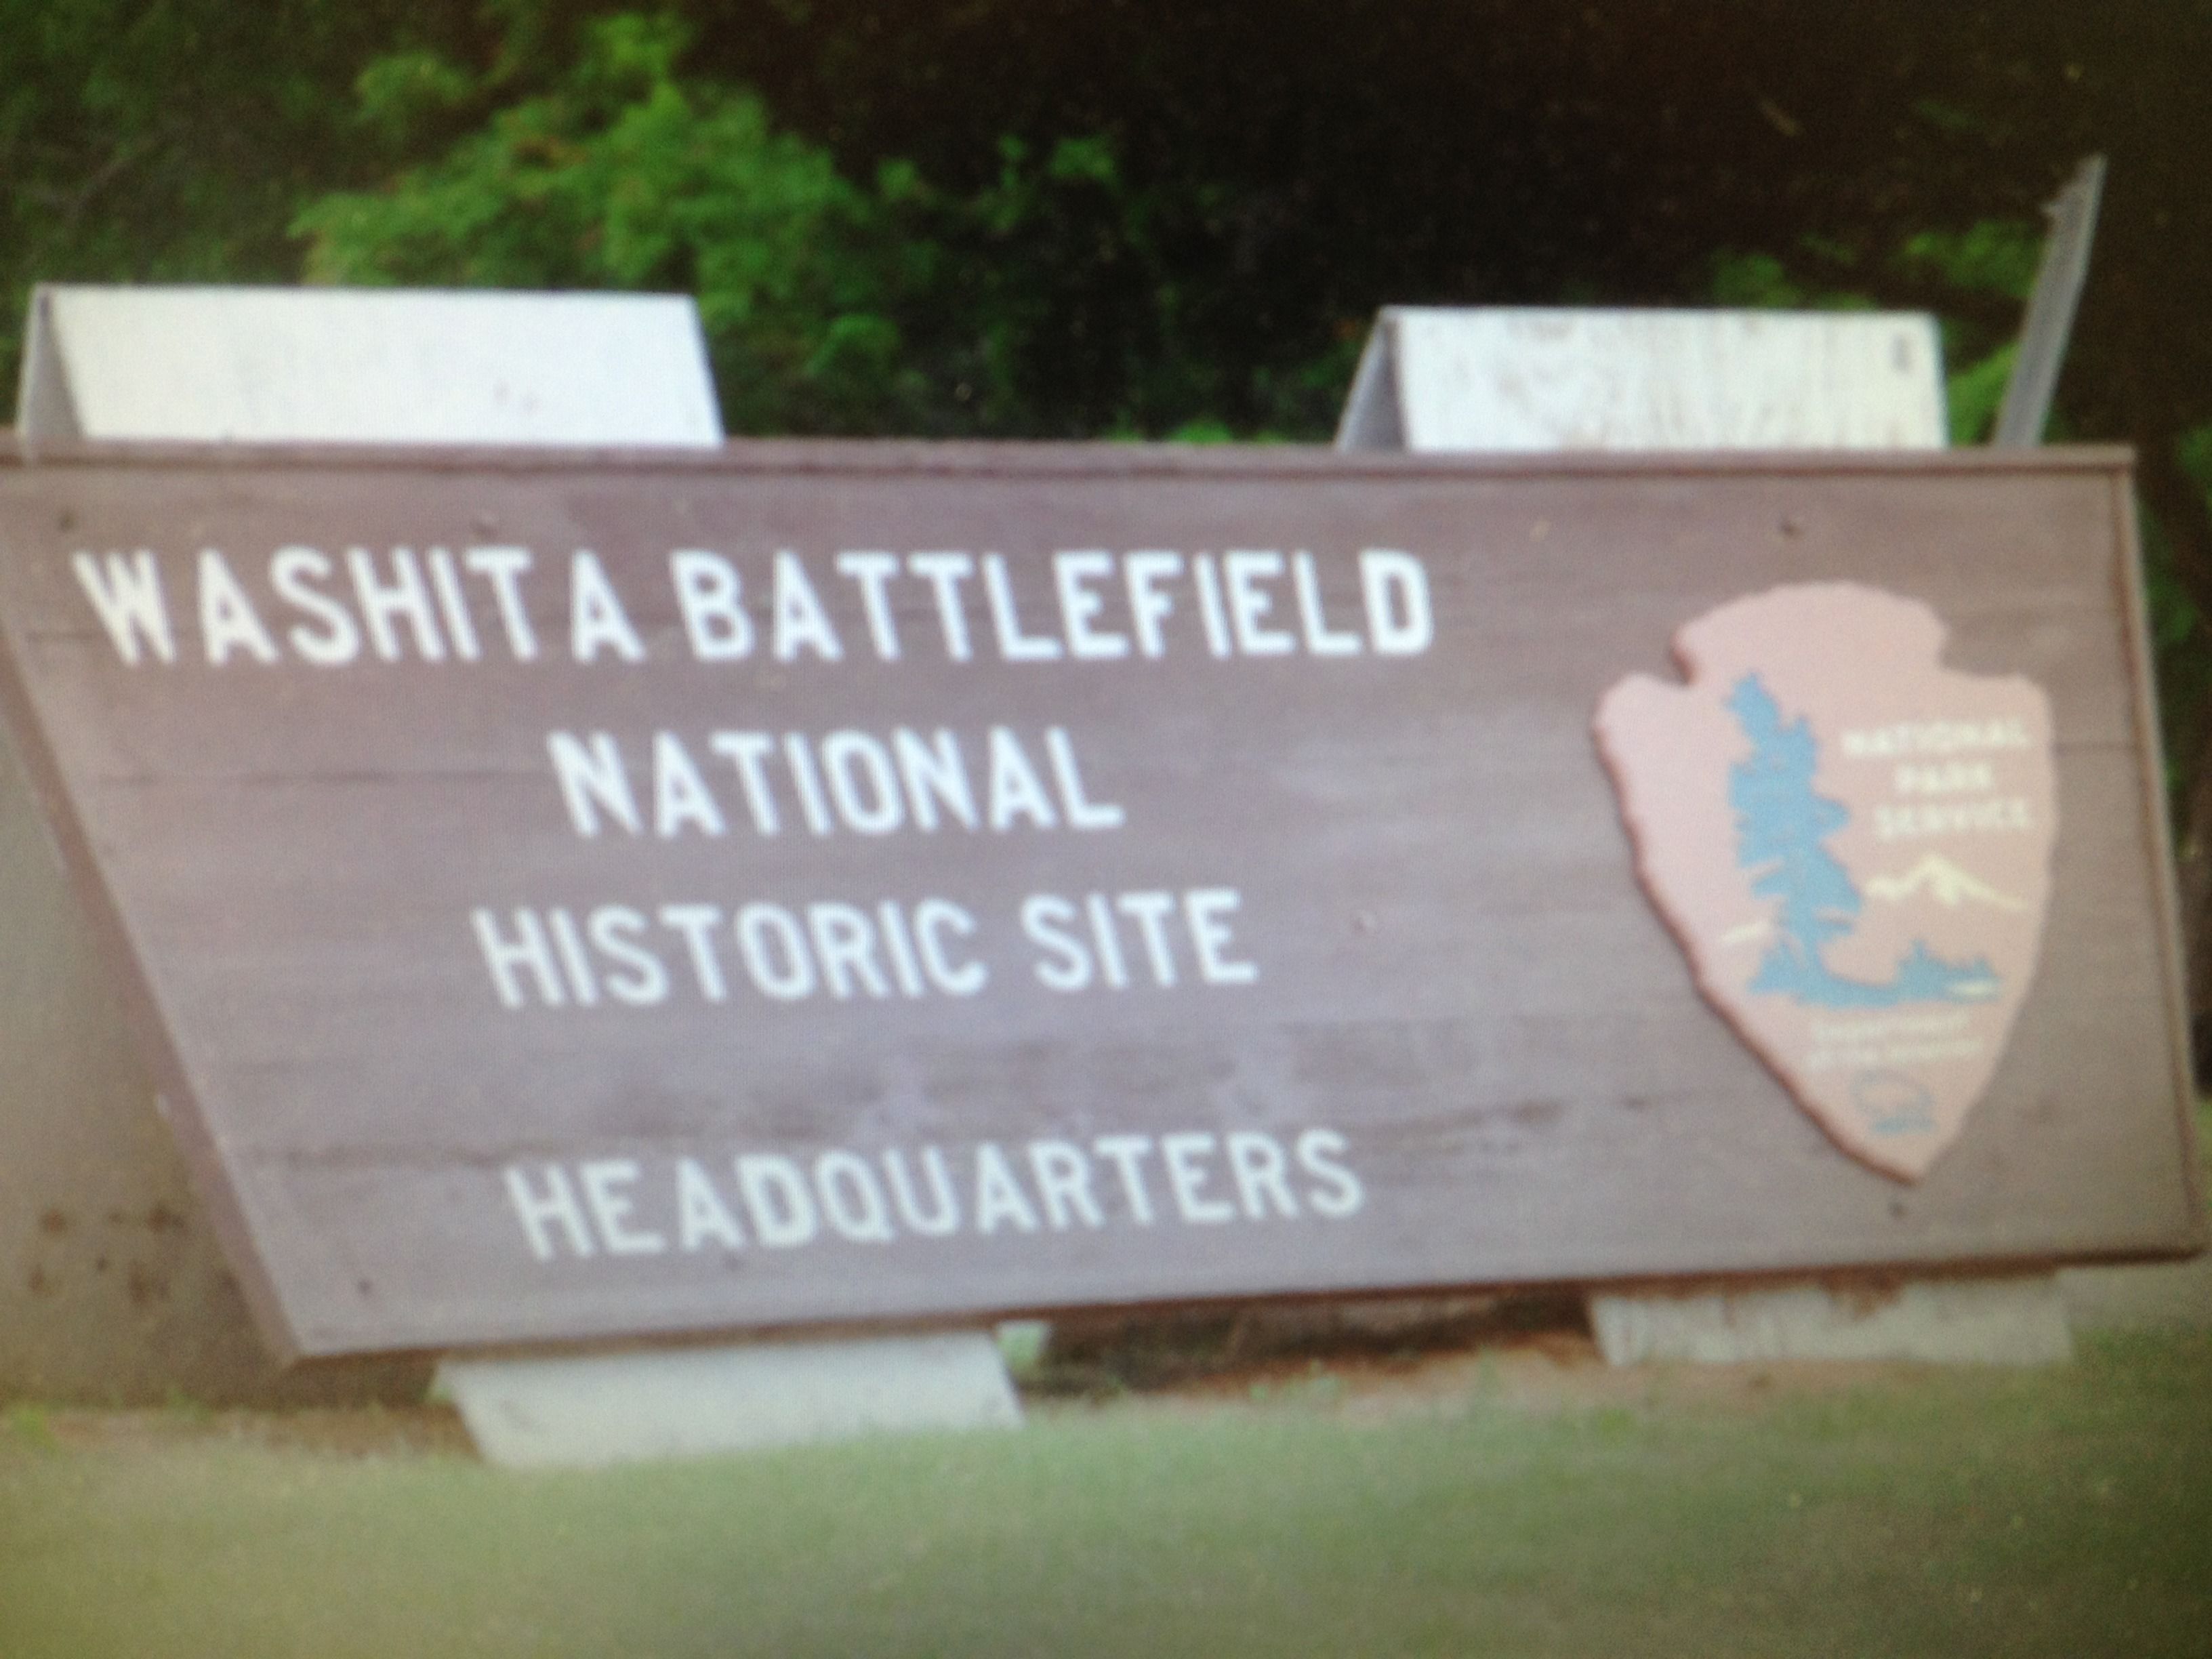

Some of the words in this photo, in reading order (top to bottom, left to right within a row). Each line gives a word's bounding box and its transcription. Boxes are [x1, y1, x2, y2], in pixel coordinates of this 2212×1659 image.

[72, 546, 646, 665] WASHITA
[671, 548, 1435, 662] BATTLEFIELD
[545, 724, 1125, 838] NATIONAL
[470, 896, 988, 1008] HISTORIC
[1021, 886, 1258, 993] SITE
[503, 1126, 1365, 1261] HEADQUARTERS
